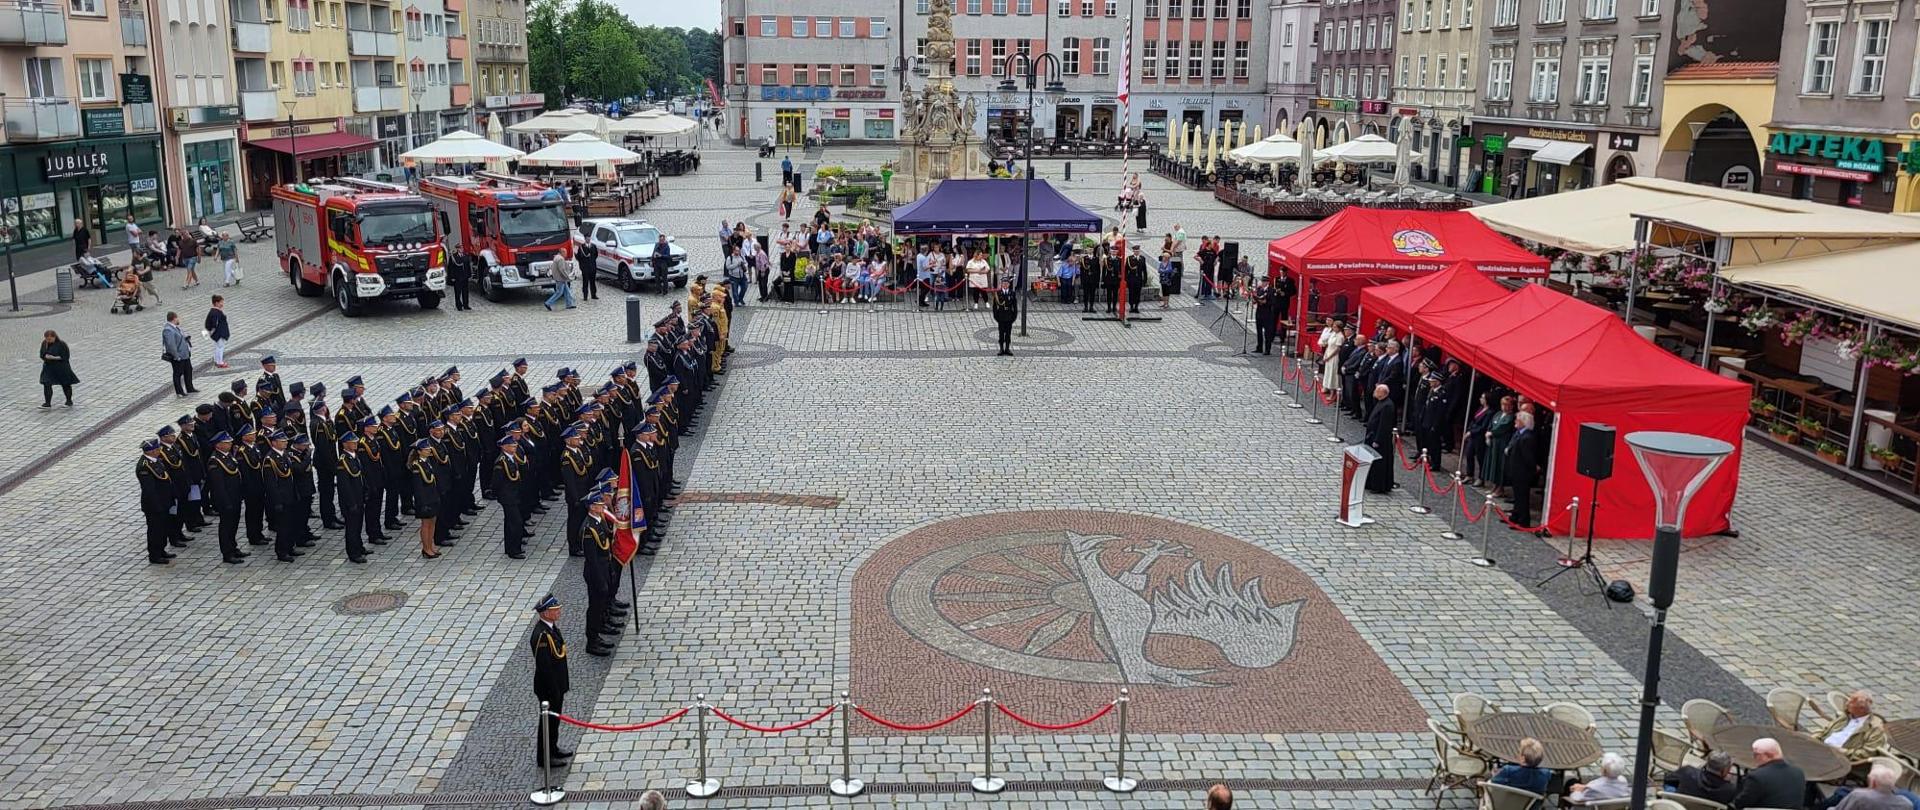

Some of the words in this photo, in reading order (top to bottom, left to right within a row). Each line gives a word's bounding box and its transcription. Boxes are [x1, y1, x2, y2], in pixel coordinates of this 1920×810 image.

[1771, 132, 1884, 161] APTEKA
[47, 153, 108, 171] JUBILER
[131, 180, 155, 191] CASIO
